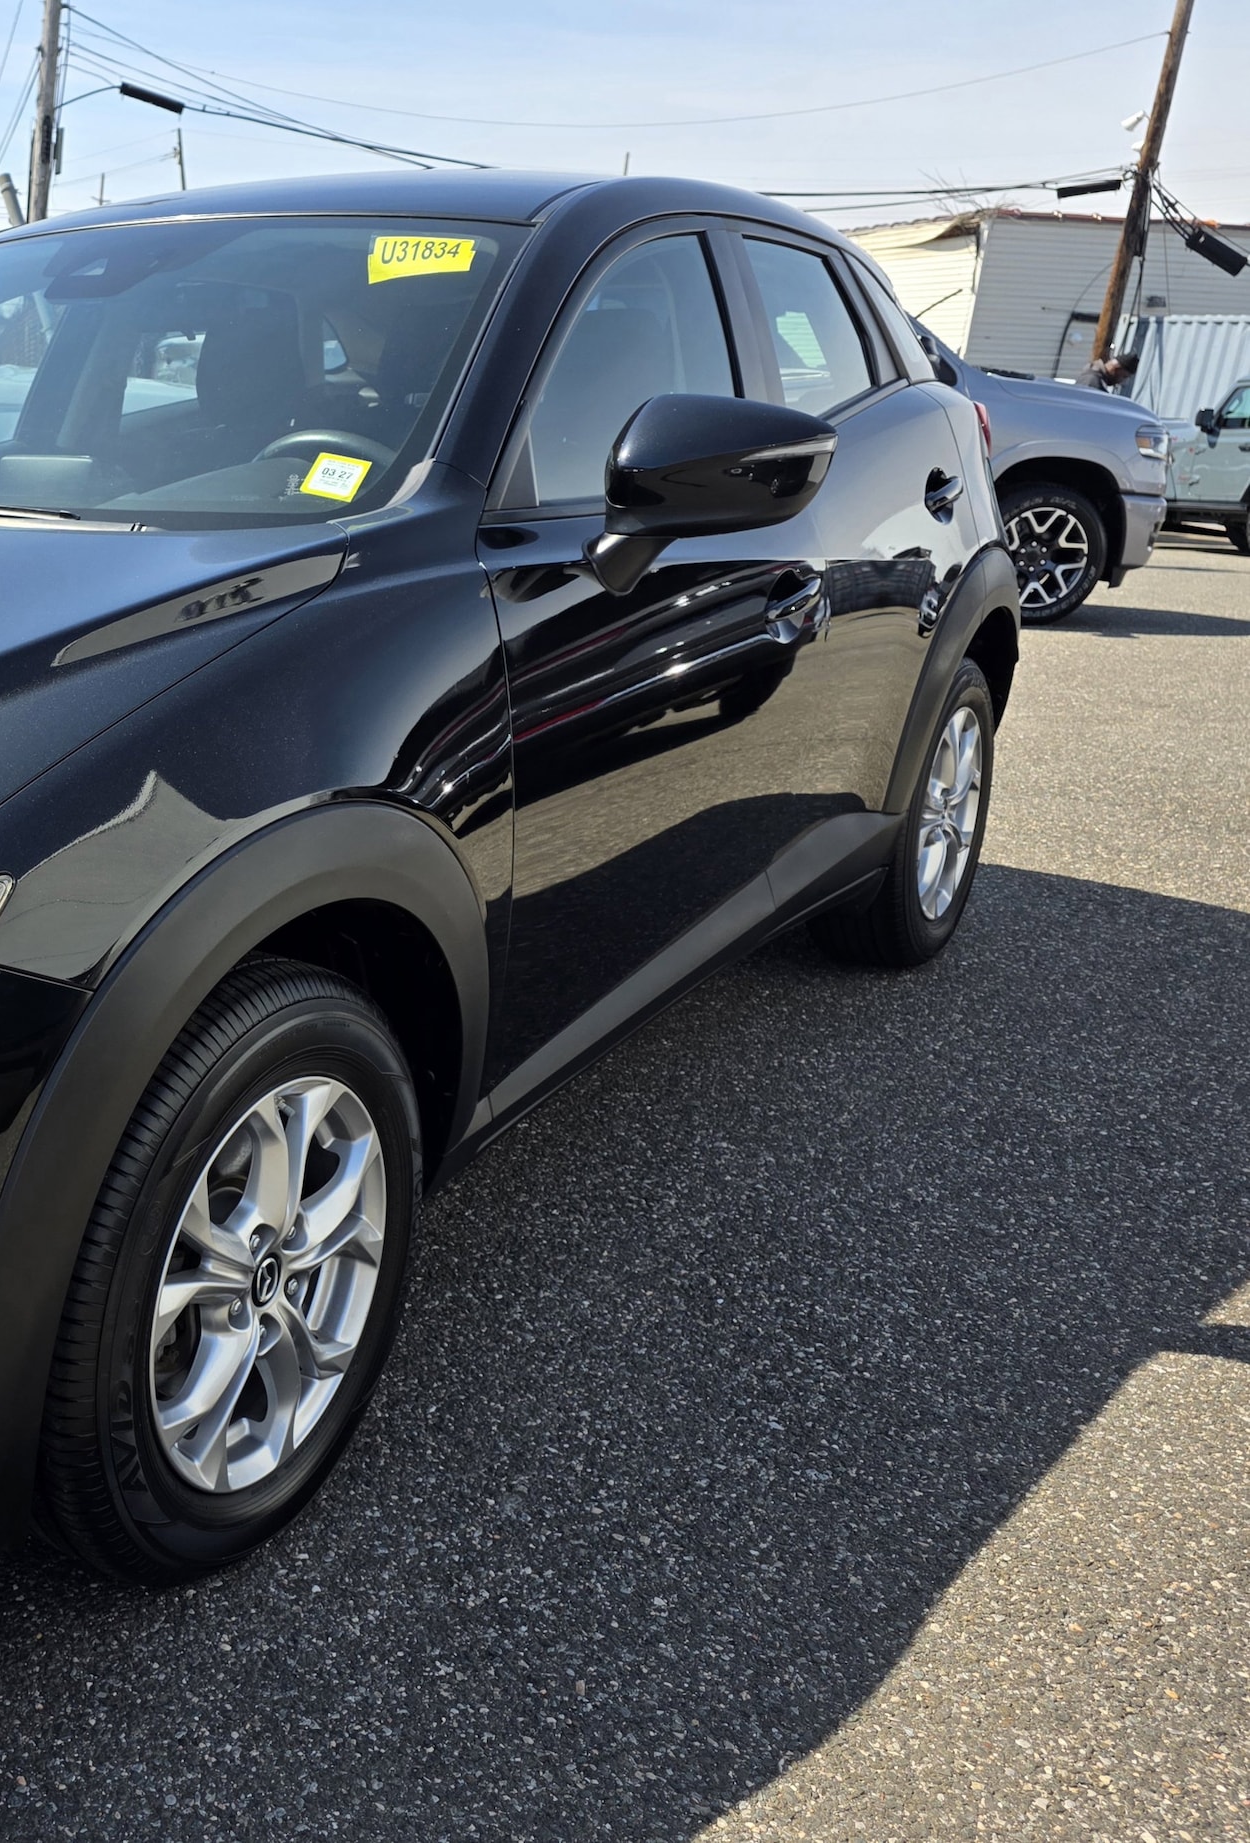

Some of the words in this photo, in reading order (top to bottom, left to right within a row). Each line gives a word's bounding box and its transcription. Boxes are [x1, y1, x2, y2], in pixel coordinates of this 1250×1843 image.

[381, 240, 462, 264] U31834
[321, 467, 336, 477] 03
[338, 470, 353, 480] 27
